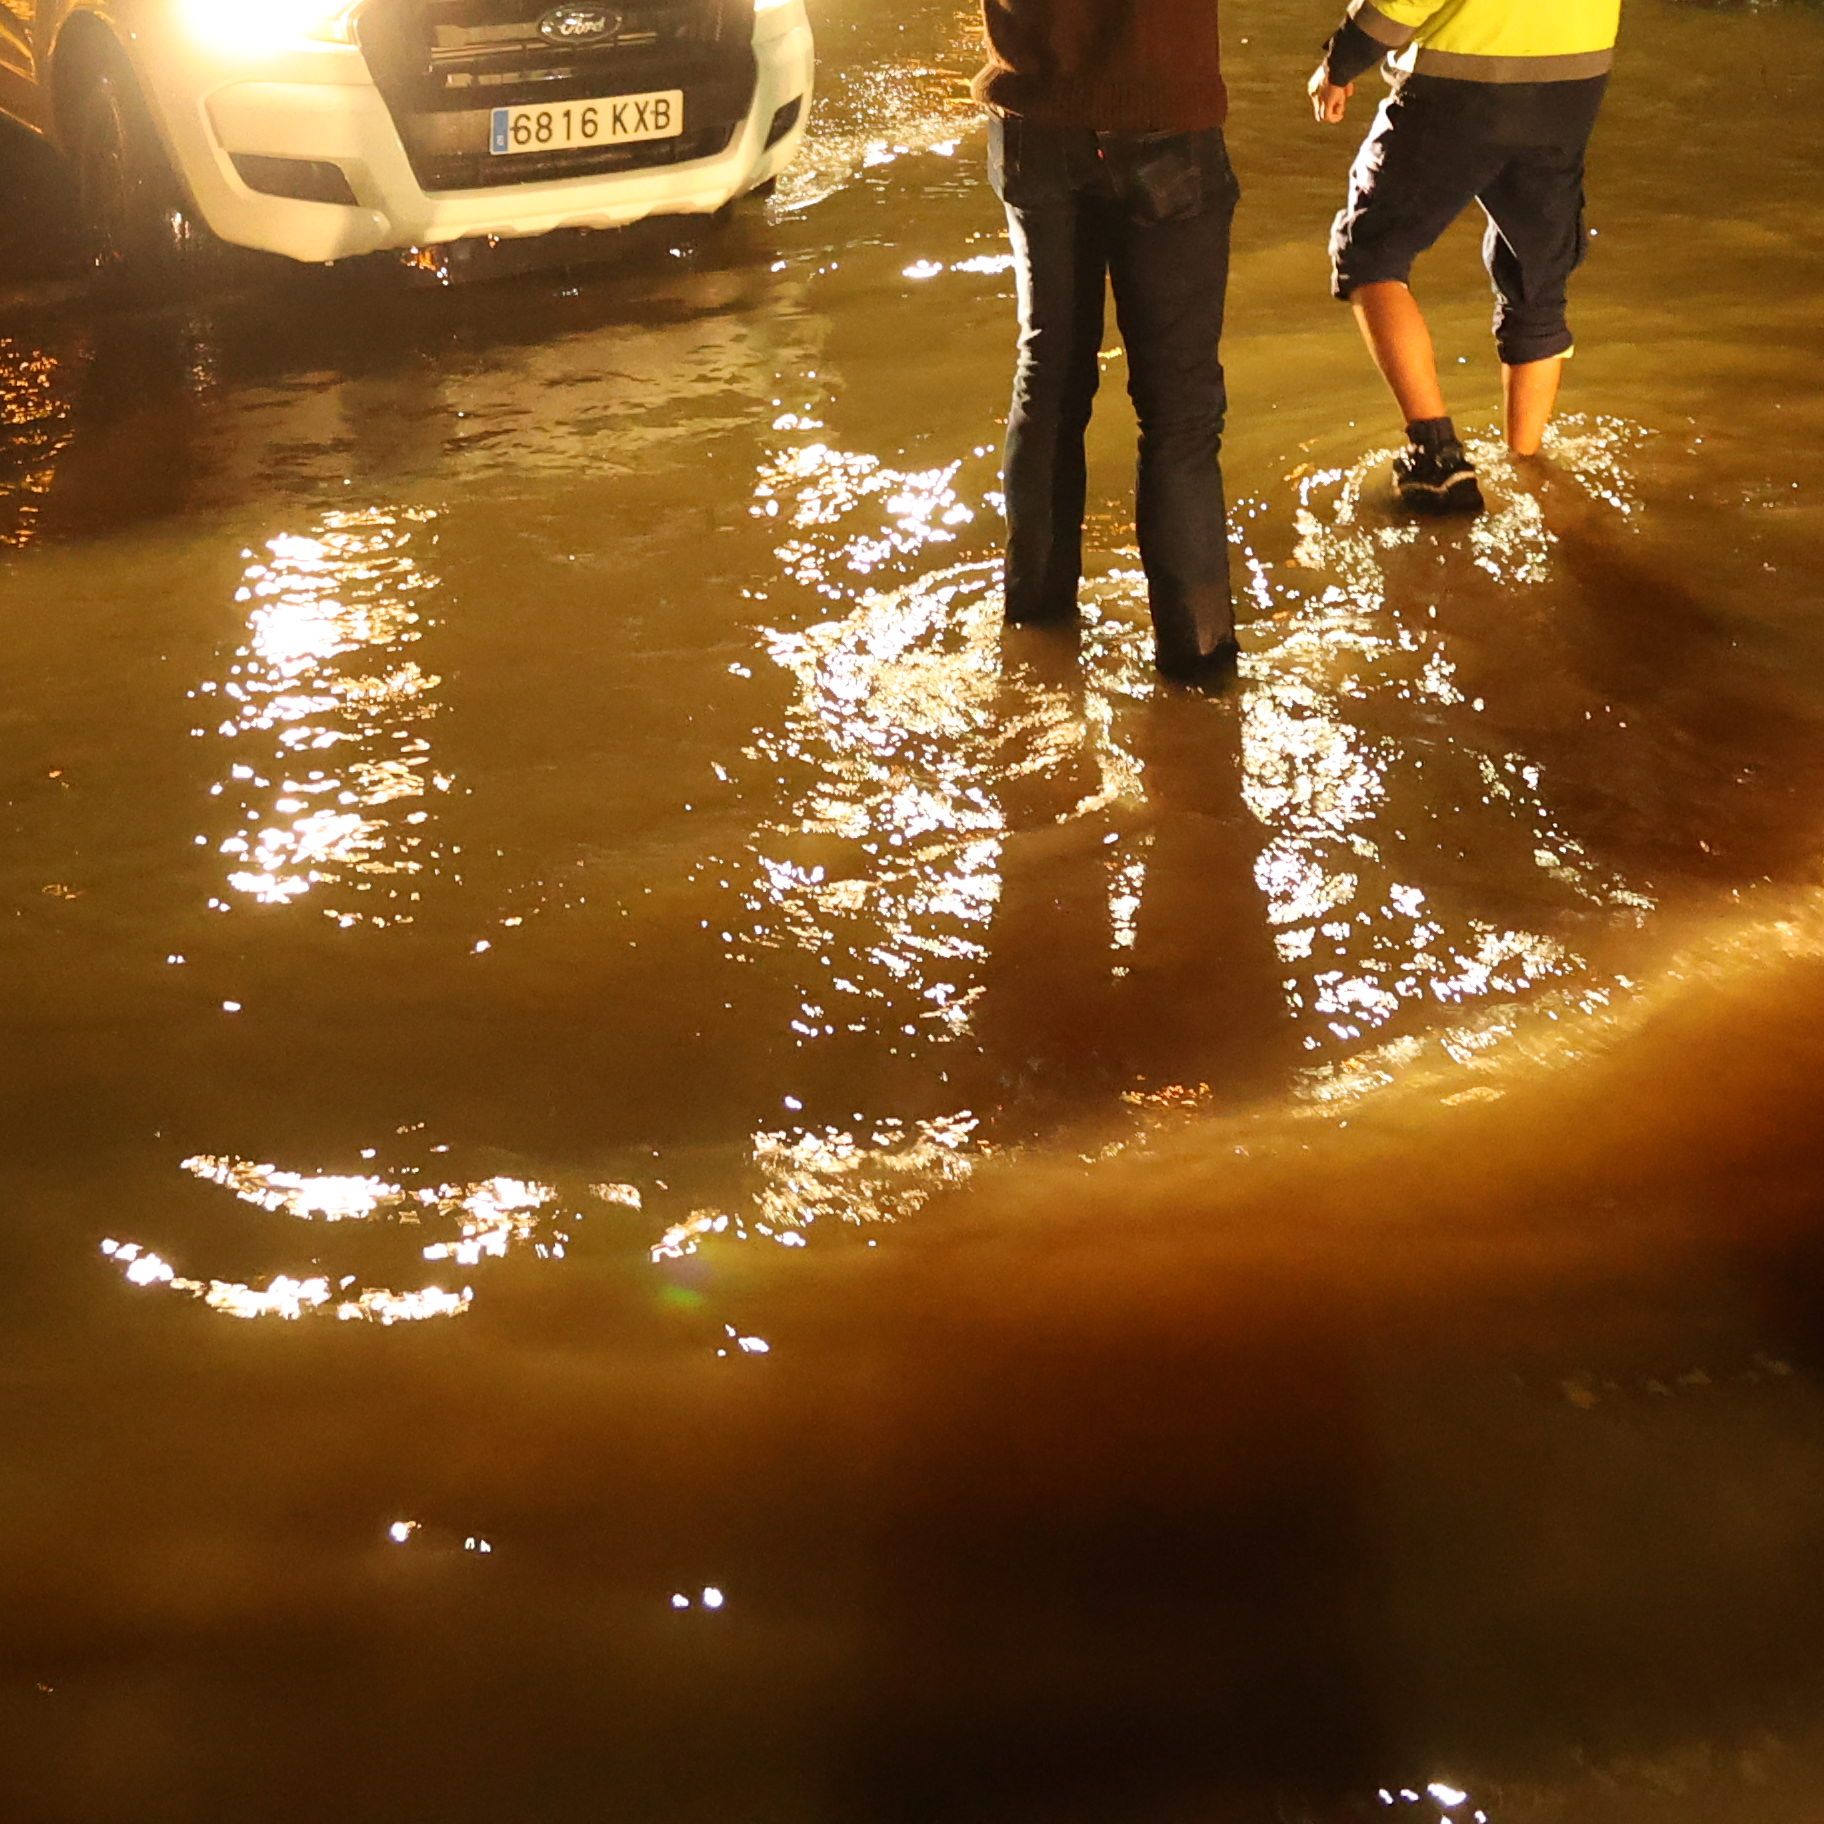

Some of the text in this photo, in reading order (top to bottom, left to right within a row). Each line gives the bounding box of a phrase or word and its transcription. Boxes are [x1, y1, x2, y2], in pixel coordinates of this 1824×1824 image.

[558, 14, 606, 35] Ford
[513, 99, 671, 145] 6816 KXB
